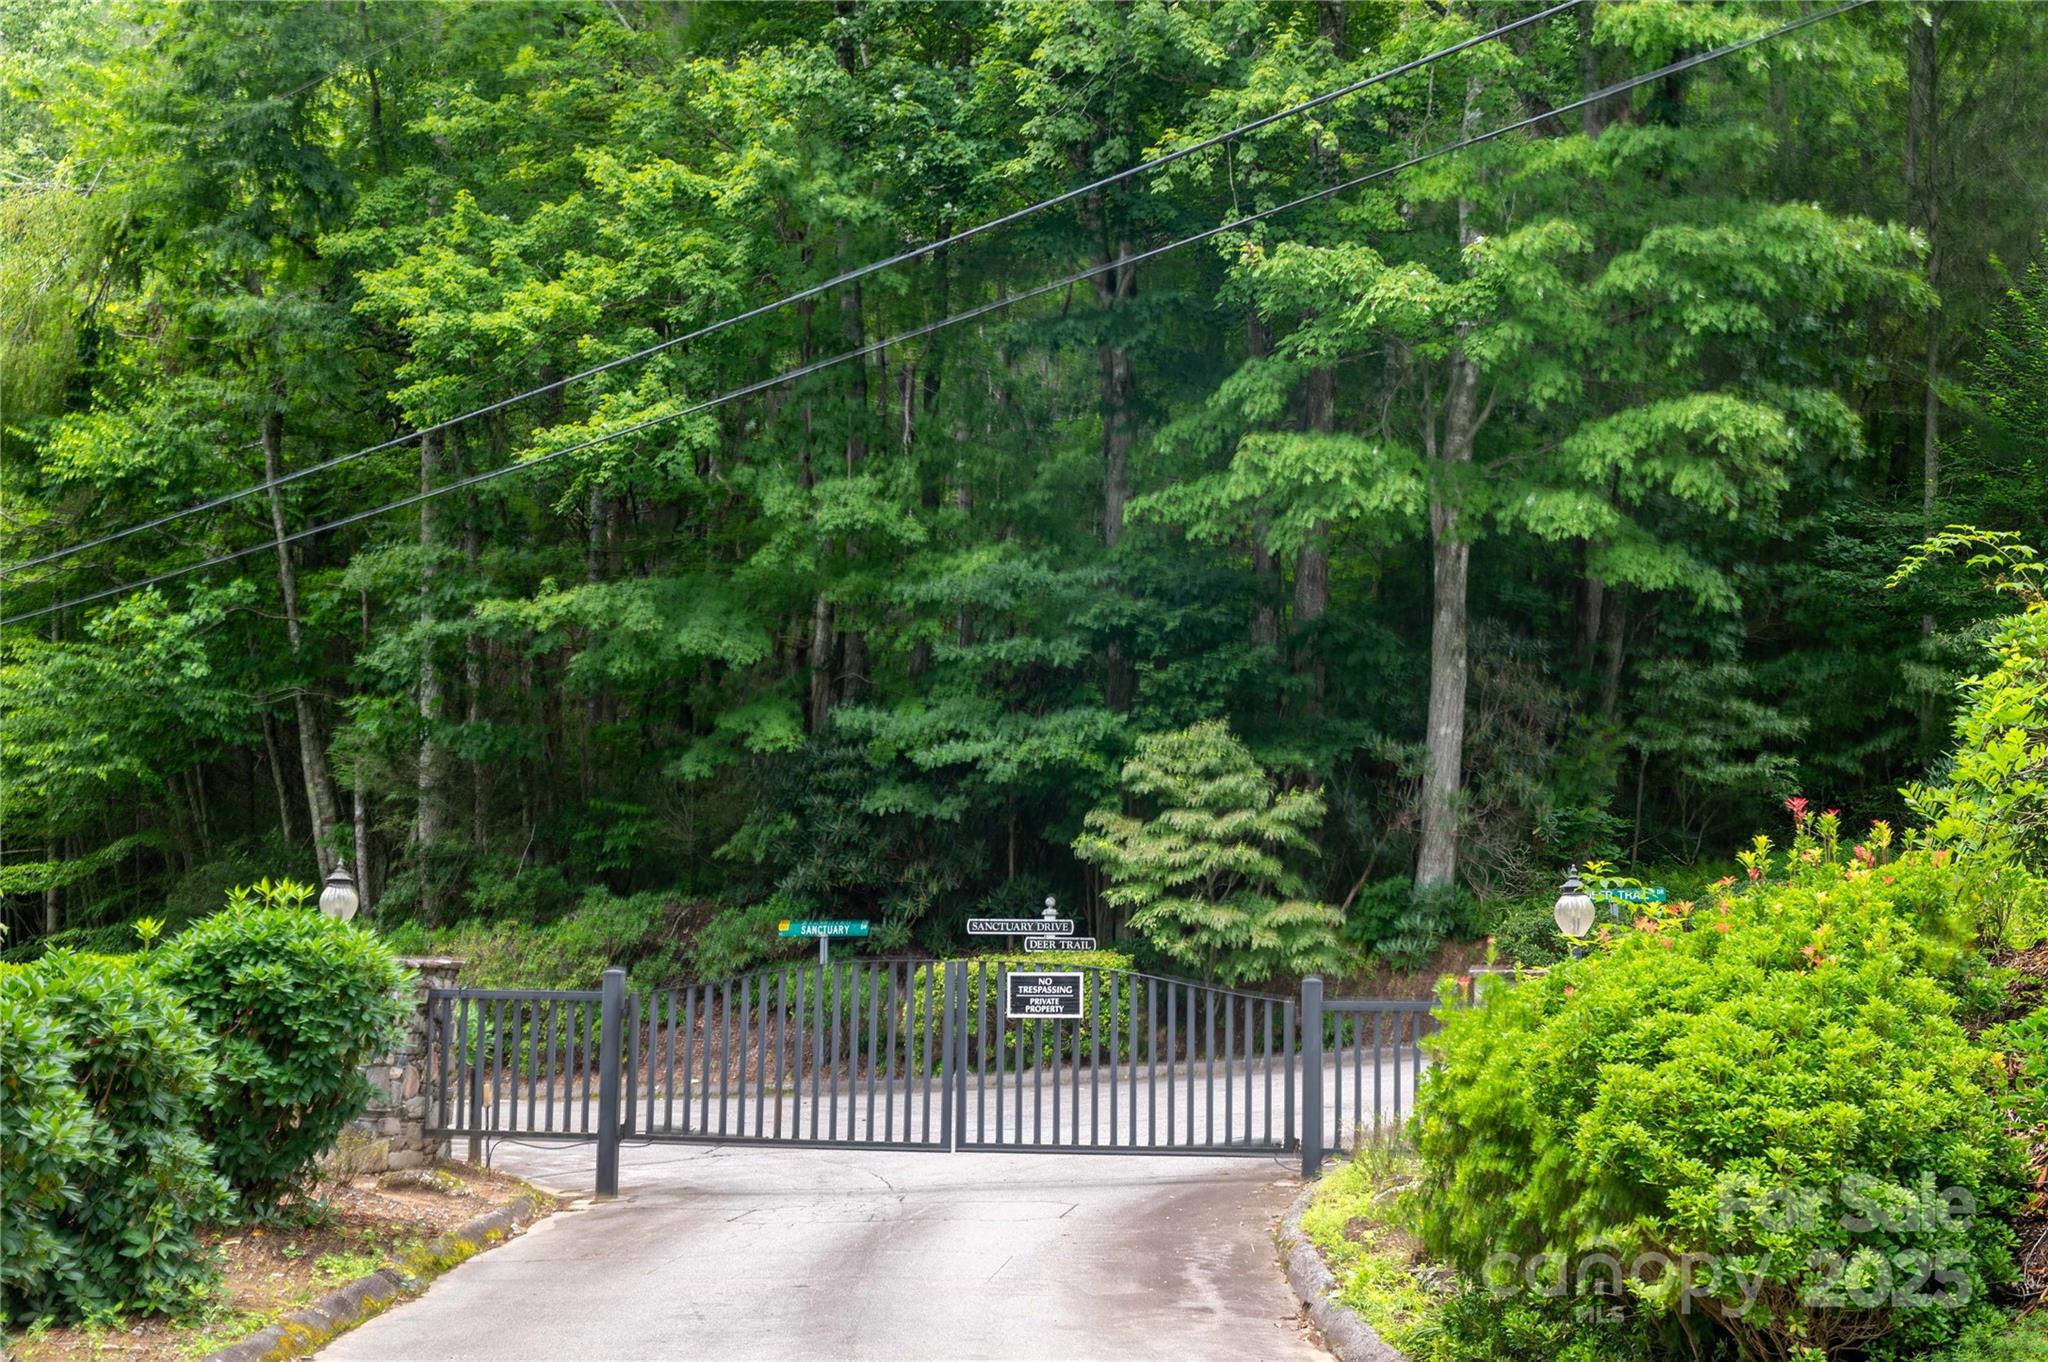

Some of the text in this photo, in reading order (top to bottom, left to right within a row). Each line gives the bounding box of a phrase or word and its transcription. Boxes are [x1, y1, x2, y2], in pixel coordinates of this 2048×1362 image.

[800, 925, 850, 935] SANCTUARY
[972, 922, 1069, 931] SANCTUARY DRIVE
[1029, 940, 1092, 949] DEER TRAIL
[1038, 977, 1053, 985] NO
[1018, 985, 1073, 994] TRESPASSING
[1029, 997, 1060, 1005] PRIVATE
[1025, 1005, 1065, 1013] PROPERTY
